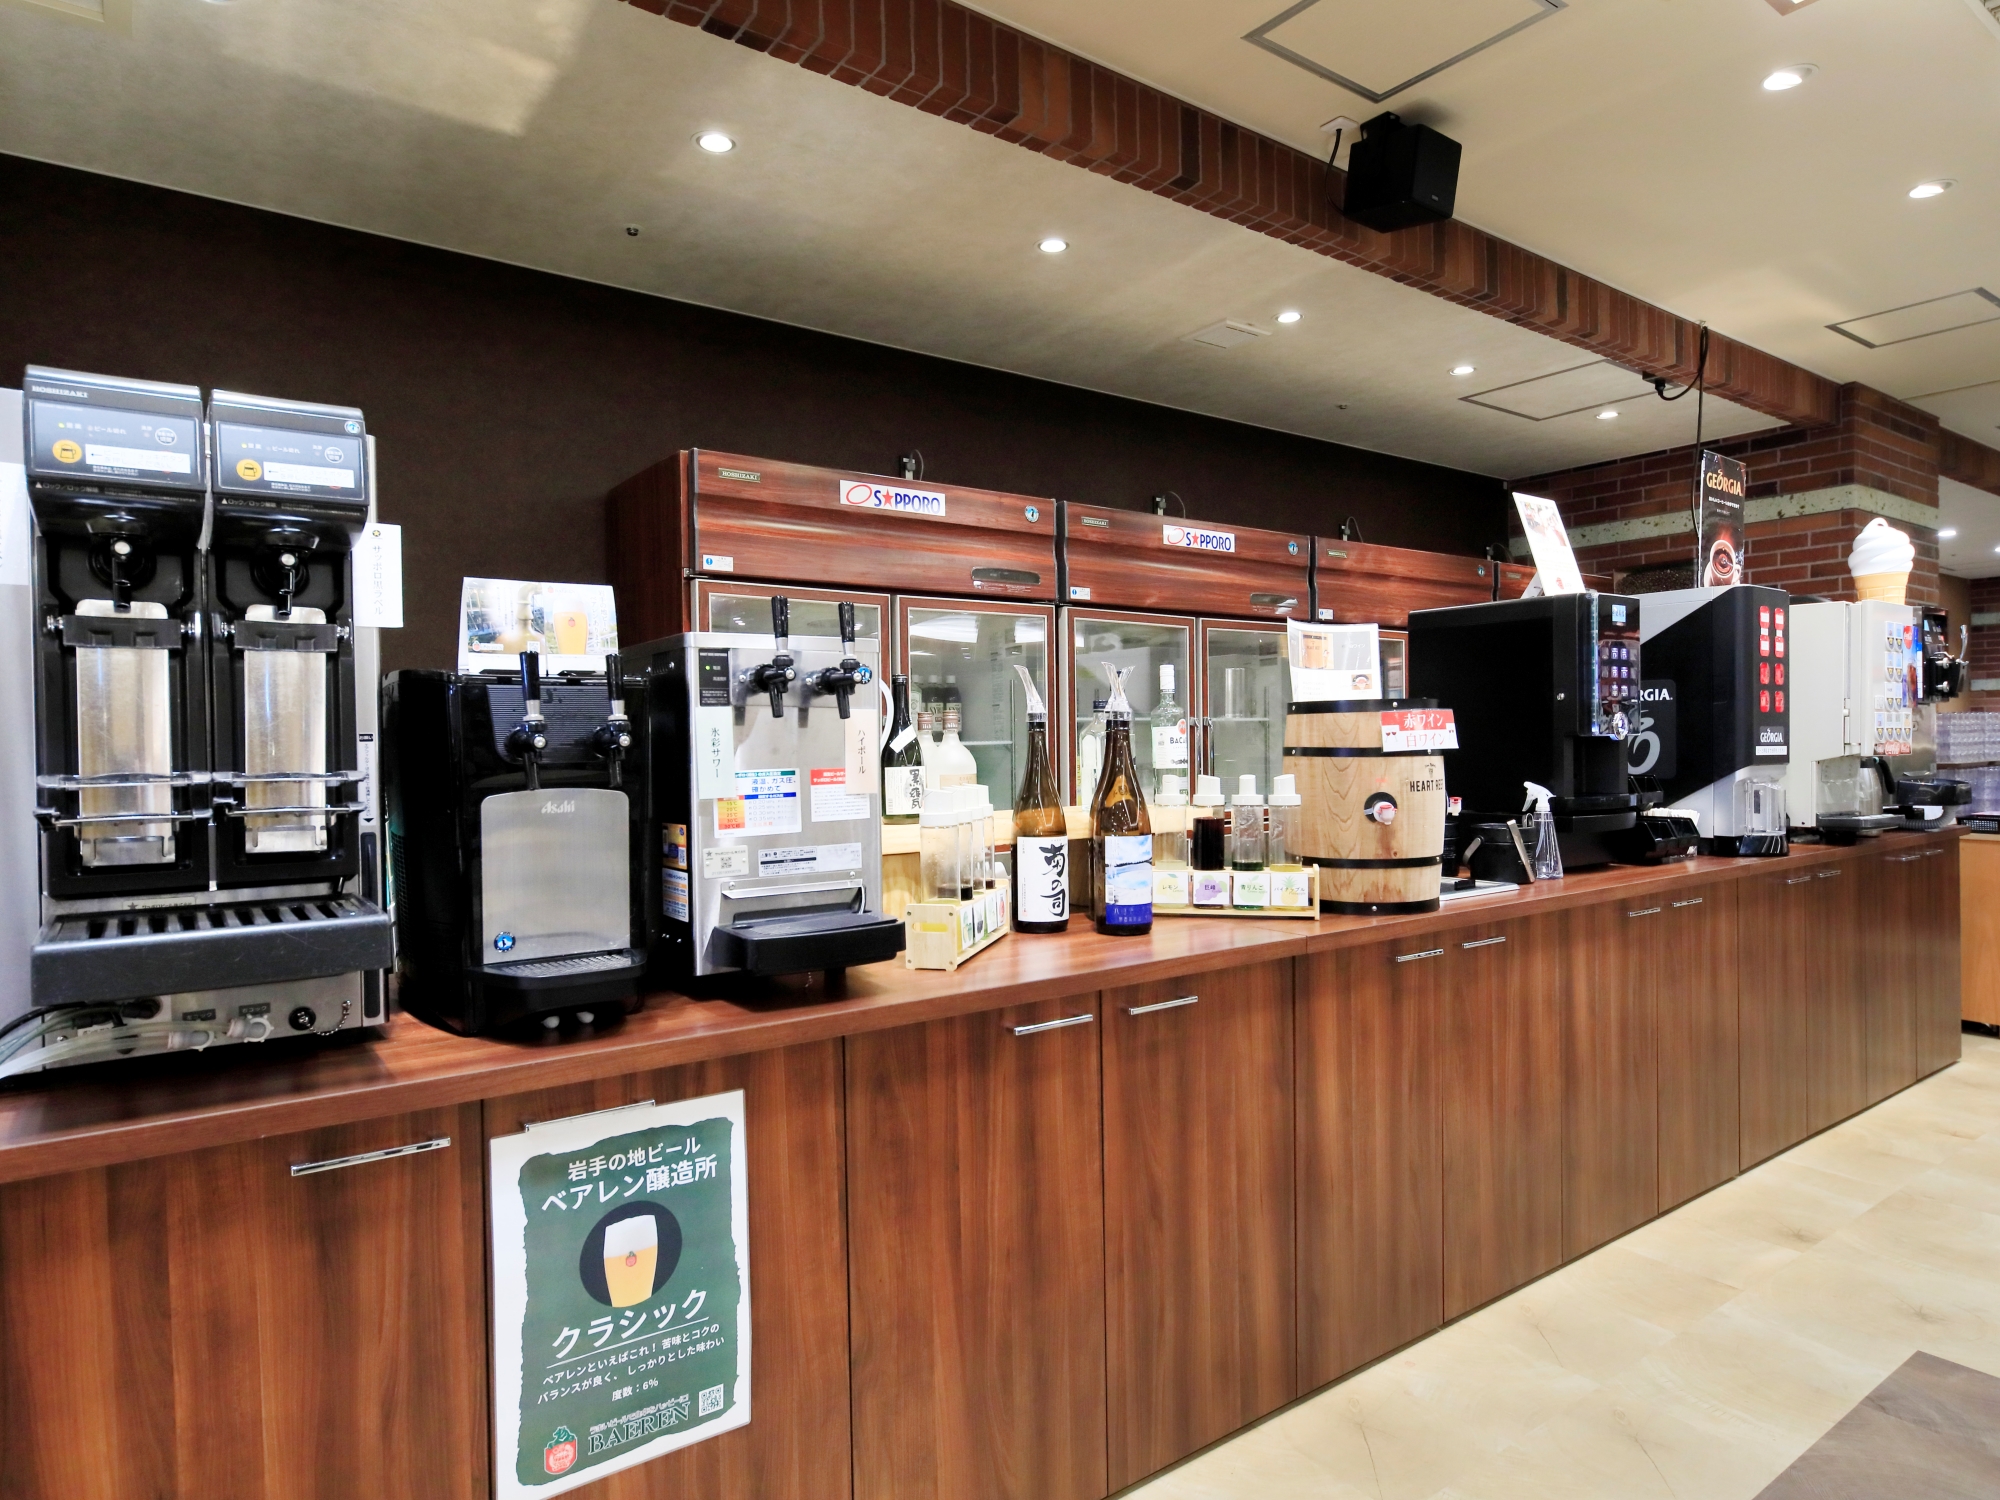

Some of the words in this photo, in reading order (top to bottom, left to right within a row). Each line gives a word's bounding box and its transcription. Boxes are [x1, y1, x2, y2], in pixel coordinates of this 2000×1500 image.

[32, 385, 89, 398] HOSHIZAKI
[722, 470, 757, 480] HOSHIZAKI
[1706, 469, 1743, 496] GEORGIA
[372, 545, 383, 615] サッポロ黒ラベル
[1640, 688, 1670, 701] RGIA
[1404, 713, 1443, 728] 赤ワイン
[1760, 728, 1783, 743] GEORGIA
[711, 727, 721, 778] 氷彩サワー
[857, 729, 867, 775] ハイボール
[1406, 733, 1445, 748] 白ワイン
[541, 799, 575, 814] Asahi
[1038, 843, 1066, 918] 菊の司
[568, 1137, 701, 1181] 岩手の地ビール
[541, 1153, 718, 1211] ベアレン醸造所
[552, 1289, 707, 1359] クラシック
[587, 1401, 691, 1455] BAEREN
